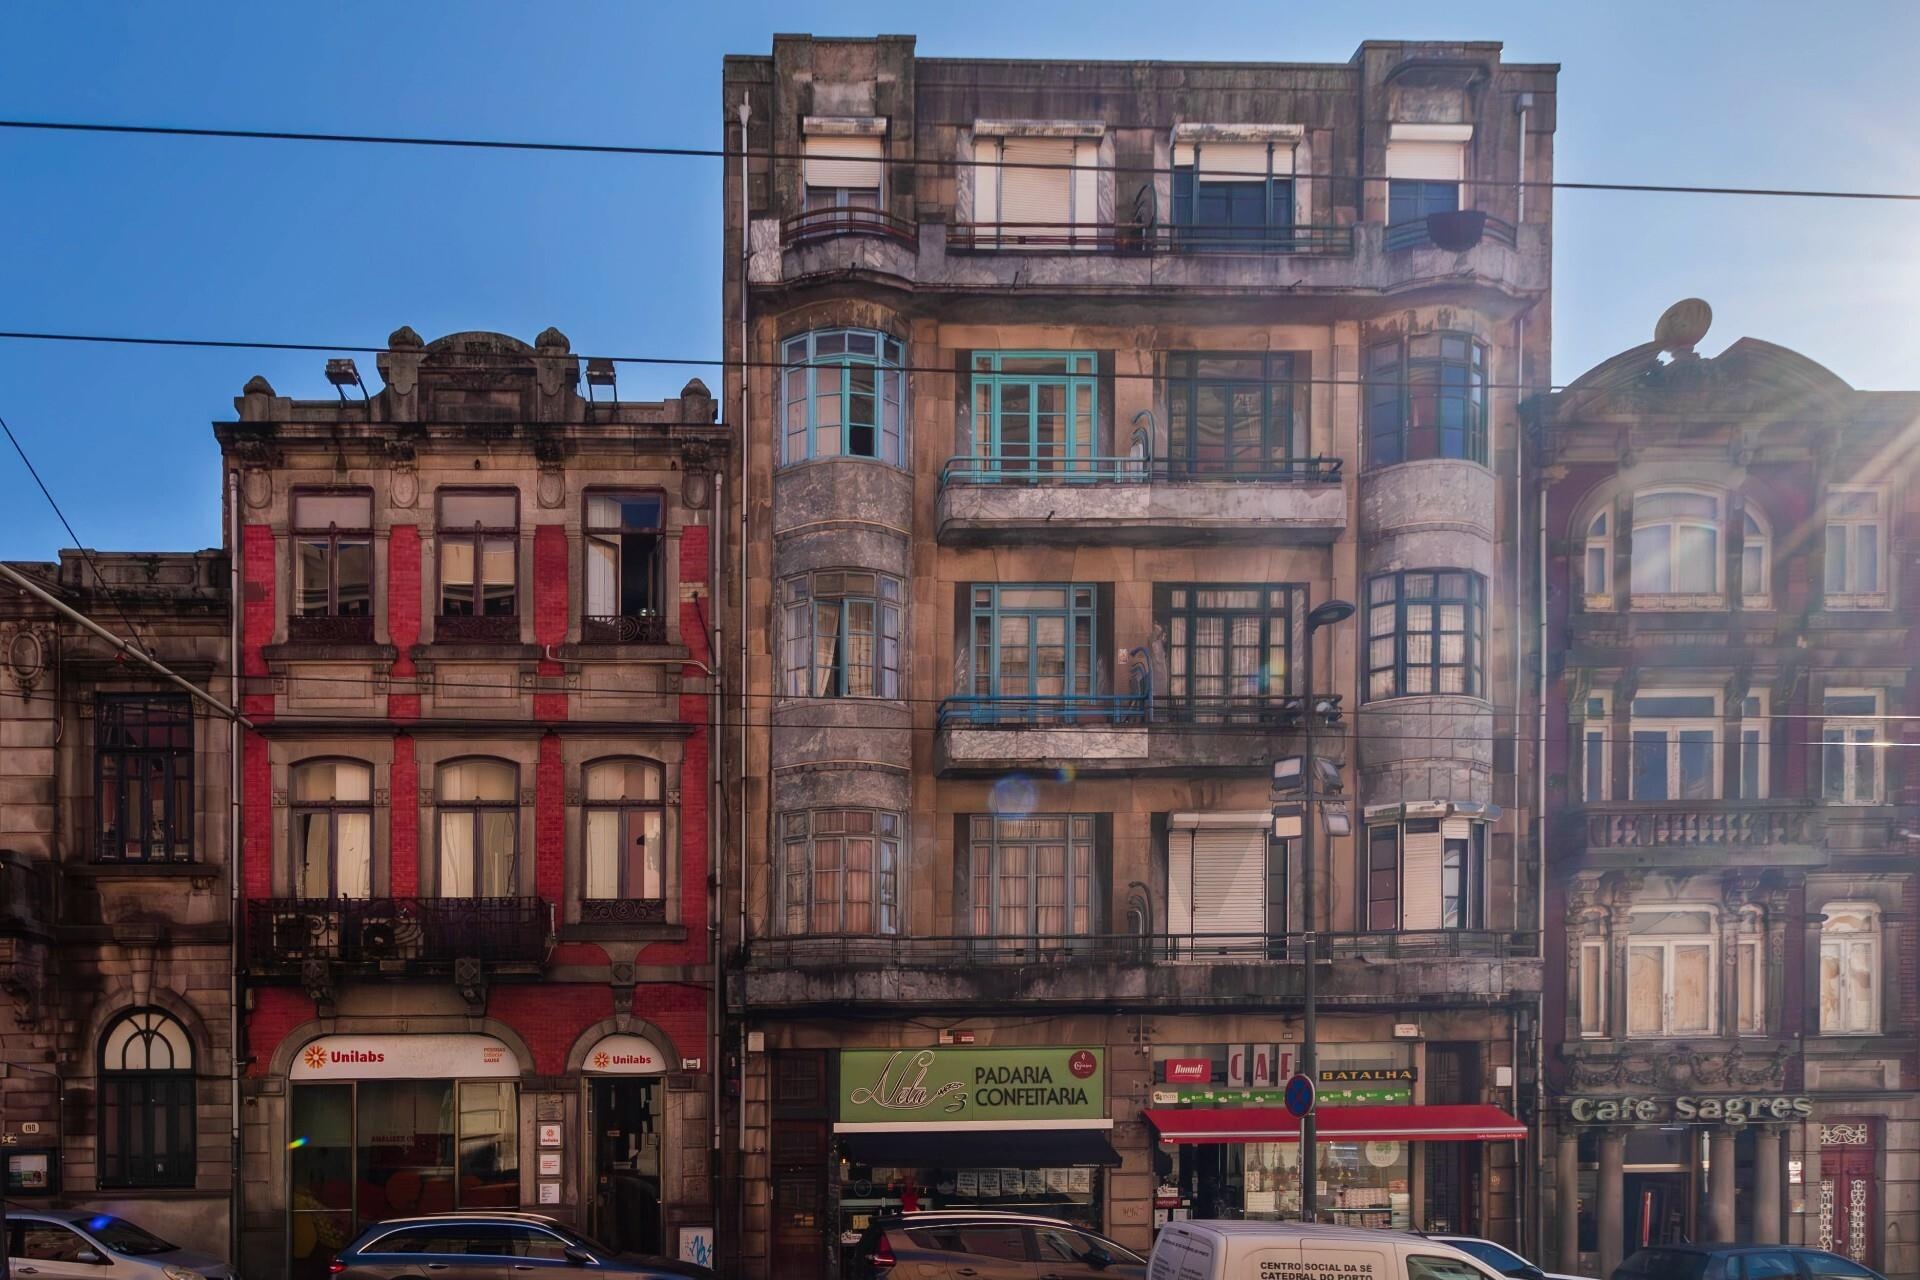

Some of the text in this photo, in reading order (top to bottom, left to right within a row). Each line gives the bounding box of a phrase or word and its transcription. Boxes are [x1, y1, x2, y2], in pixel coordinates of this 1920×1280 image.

[331, 1050, 385, 1063] Unilabs
[612, 1055, 652, 1065] Unilabs
[1230, 1052, 1293, 1081] CAF
[975, 1066, 1053, 1085] PADARIA
[1322, 1070, 1412, 1081] BATALHA
[975, 1087, 1089, 1107] CONFEITARIA
[1571, 1096, 1814, 1125] Café Sagres
[1260, 1262, 1301, 1270] CENTRO
[1304, 1263, 1341, 1272] SOCIAL
[1344, 1264, 1357, 1272] DA
[1261, 1272, 1316, 1280] CATEDRAL
